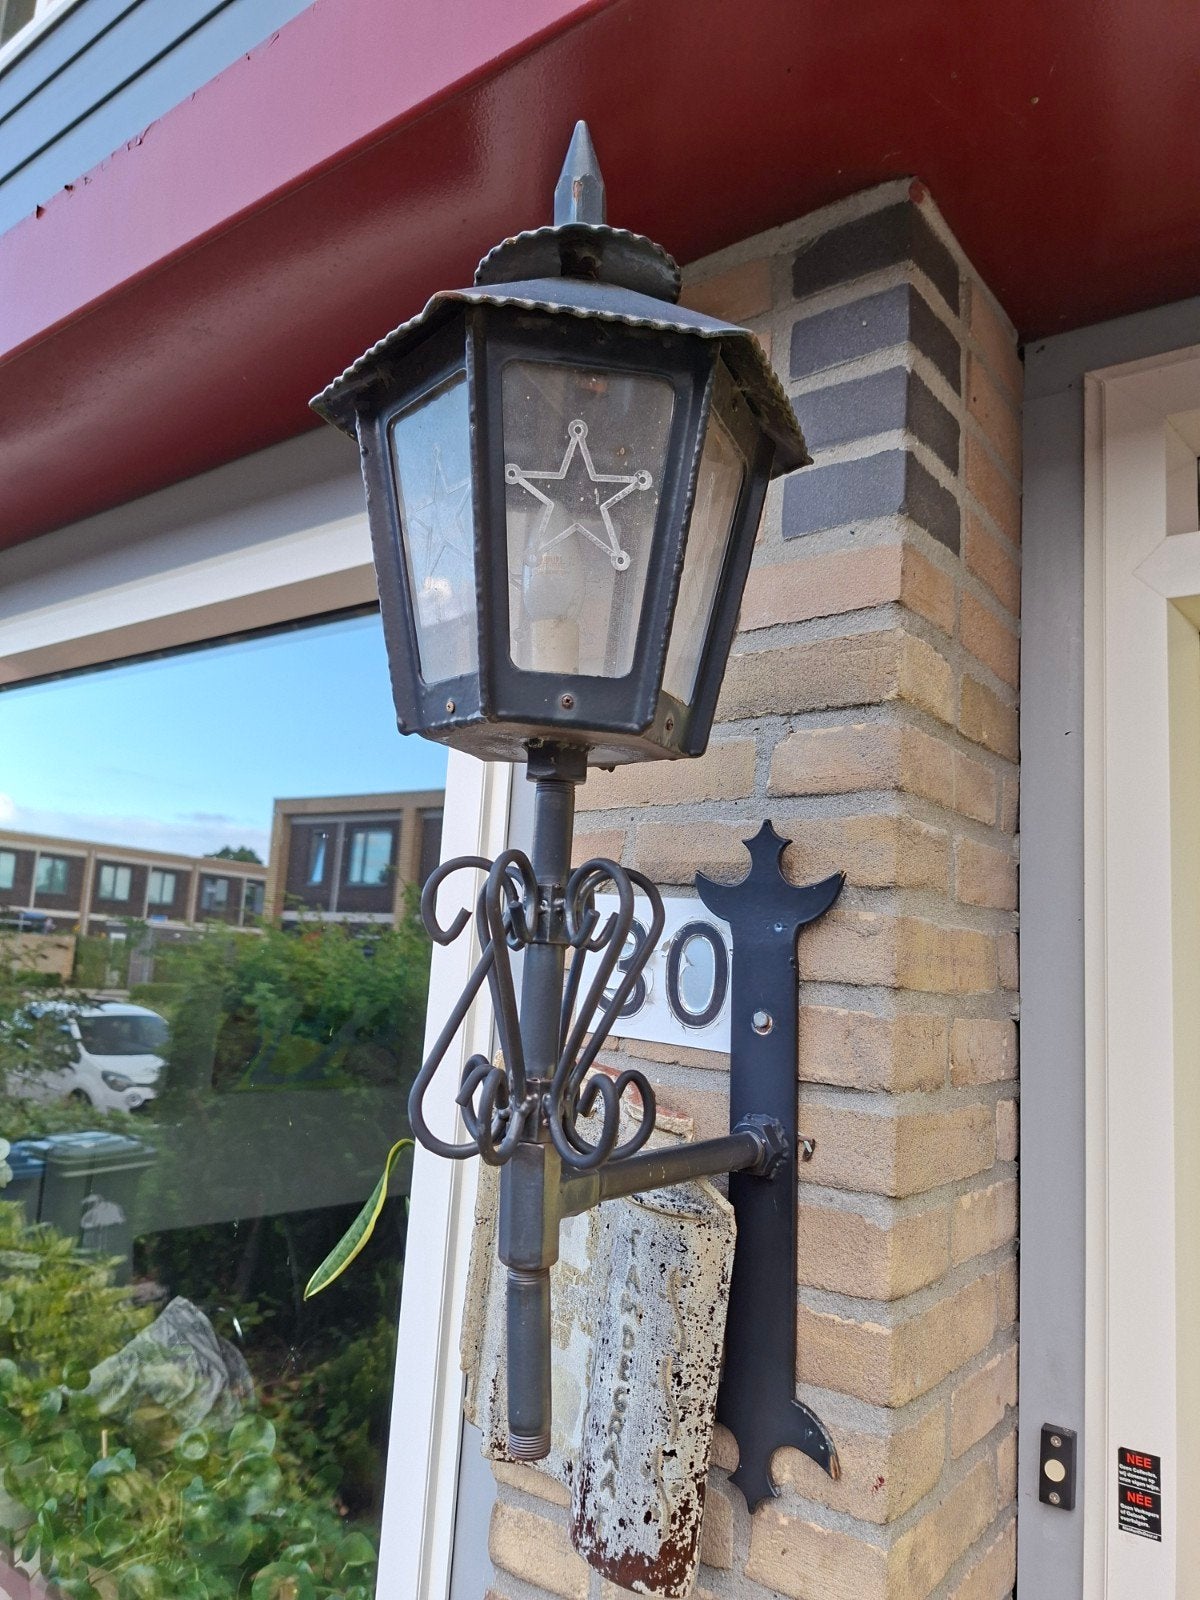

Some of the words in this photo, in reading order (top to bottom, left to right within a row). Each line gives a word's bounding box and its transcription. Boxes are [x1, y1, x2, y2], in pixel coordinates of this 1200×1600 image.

[598, 917, 729, 1030] 30
[1126, 1452, 1152, 1469] NEE
[1127, 1491, 1153, 1508] NEE
